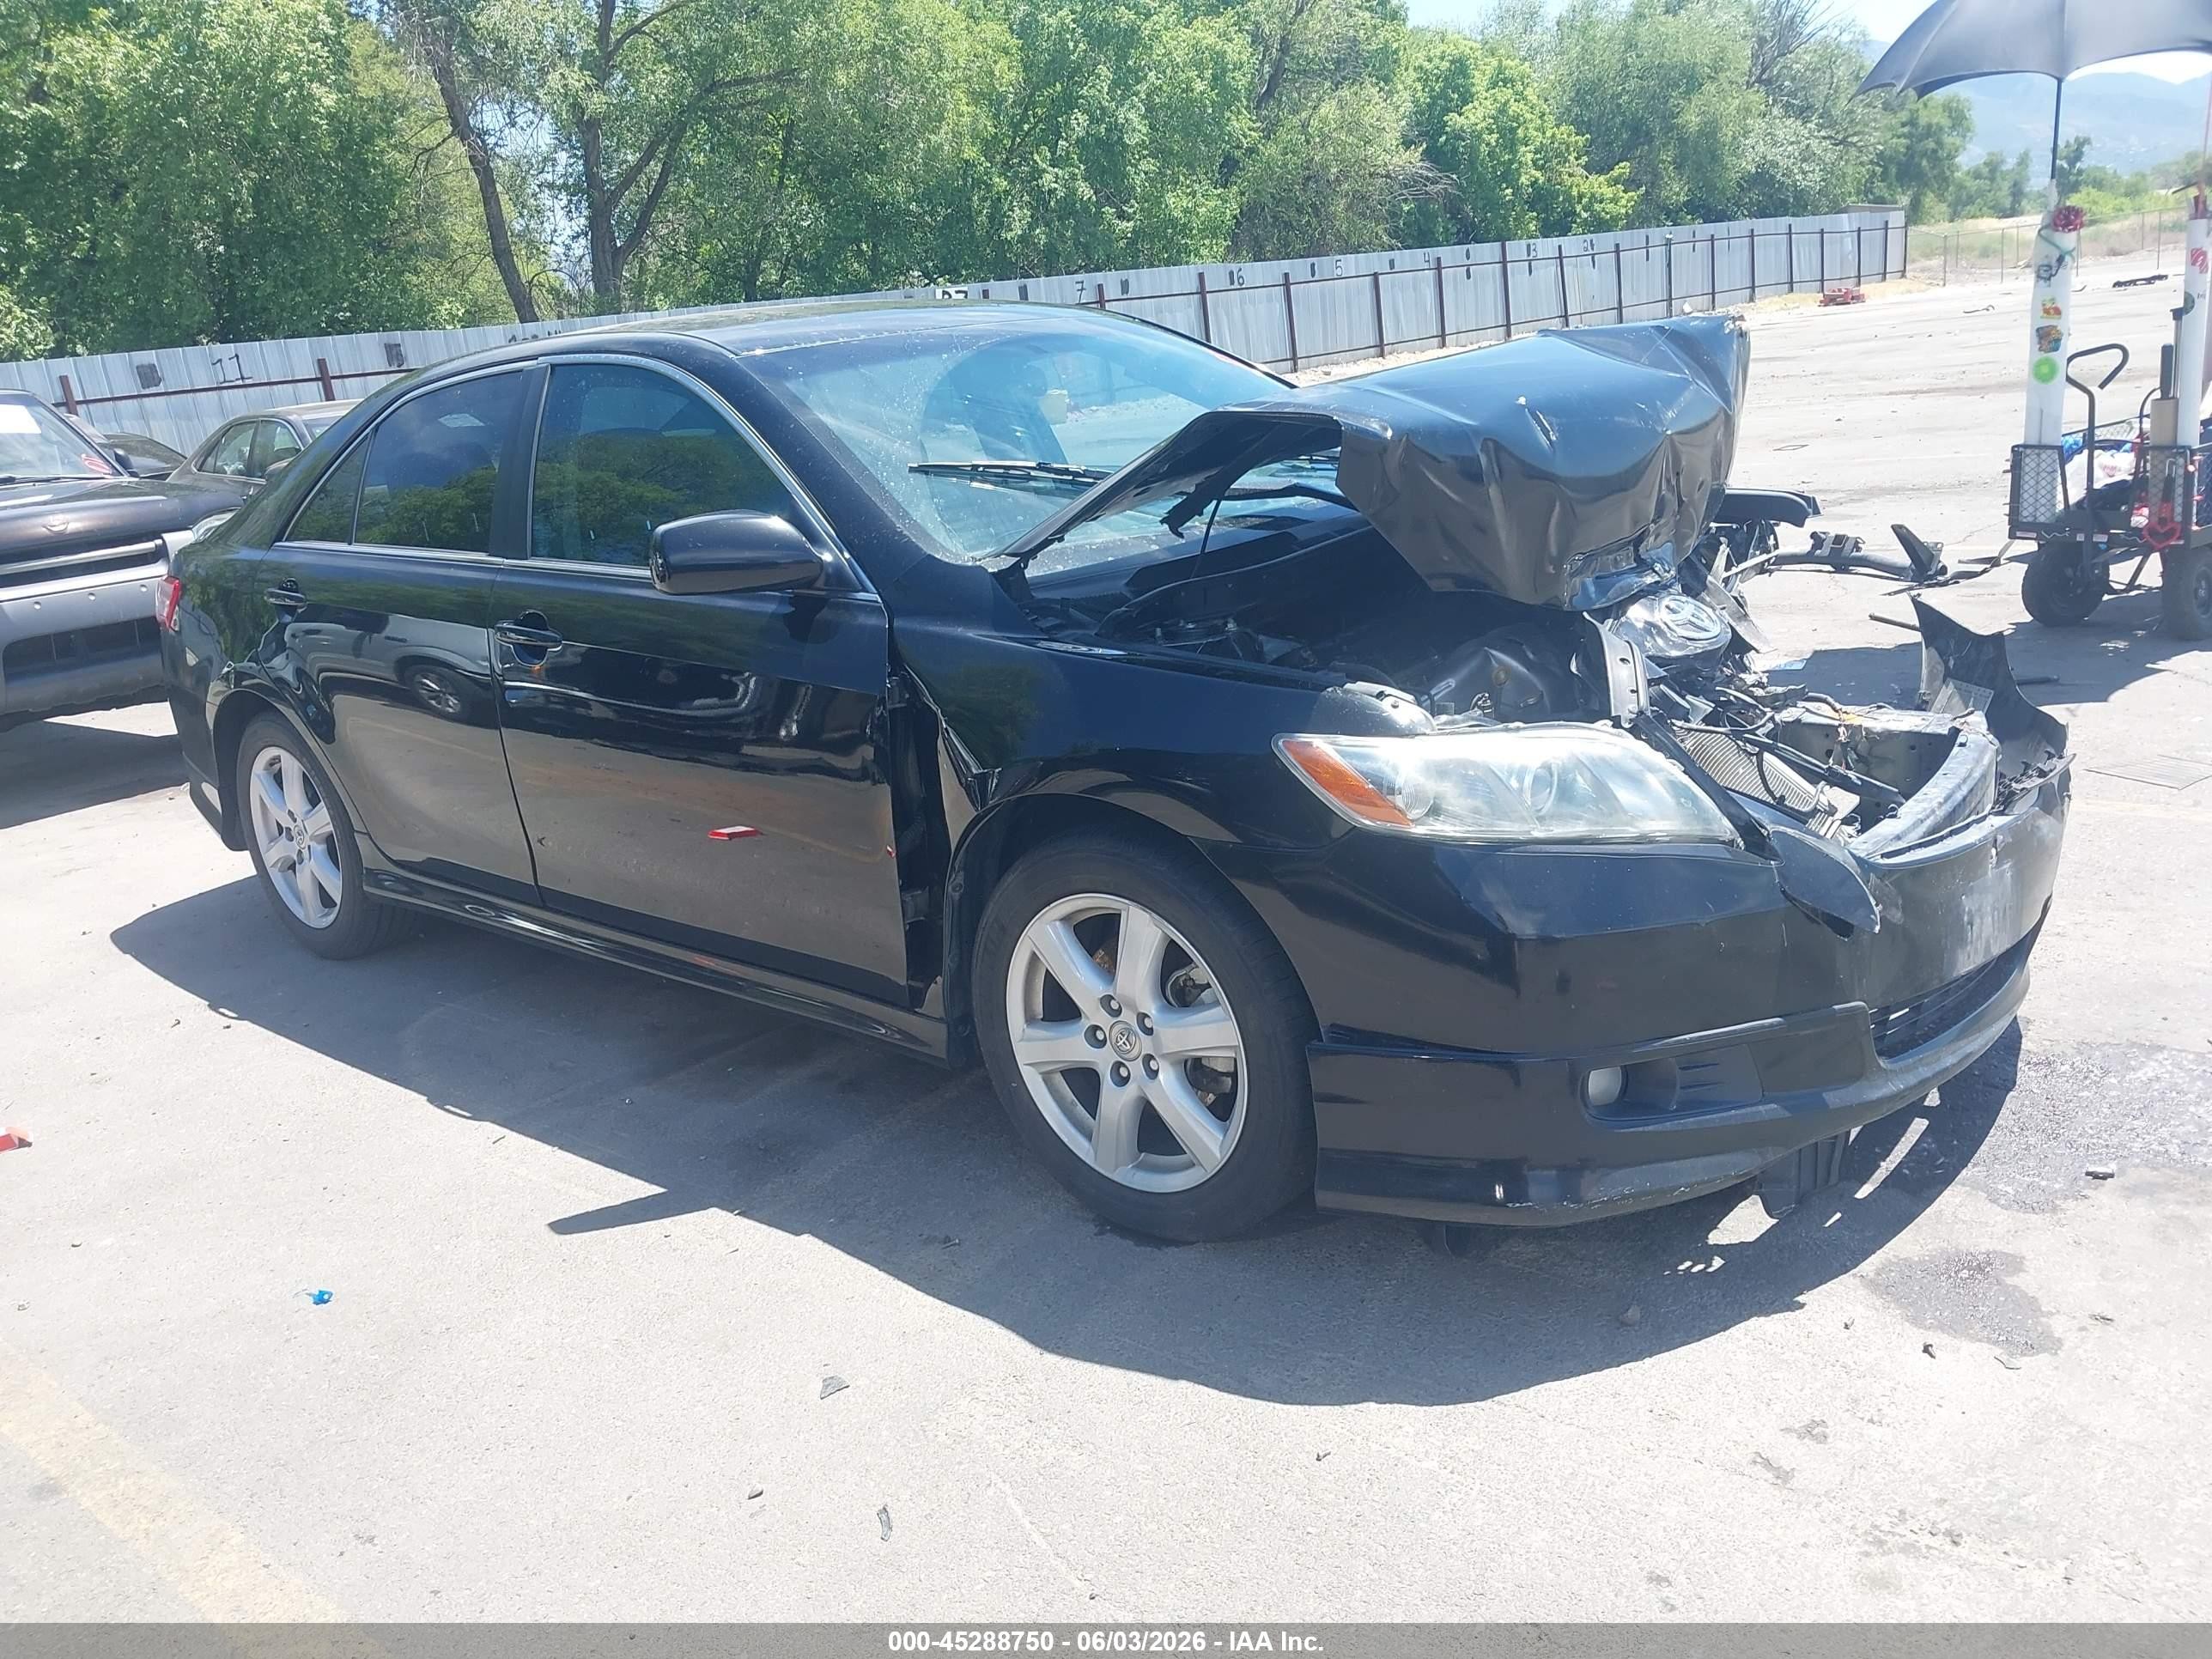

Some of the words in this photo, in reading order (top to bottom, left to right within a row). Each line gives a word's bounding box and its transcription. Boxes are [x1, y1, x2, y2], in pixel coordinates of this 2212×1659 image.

[1335, 259, 1343, 277] 5
[1423, 252, 1431, 270] 4
[1237, 267, 1246, 287] 6
[1074, 280, 1086, 305] 7
[211, 353, 253, 385] 11
